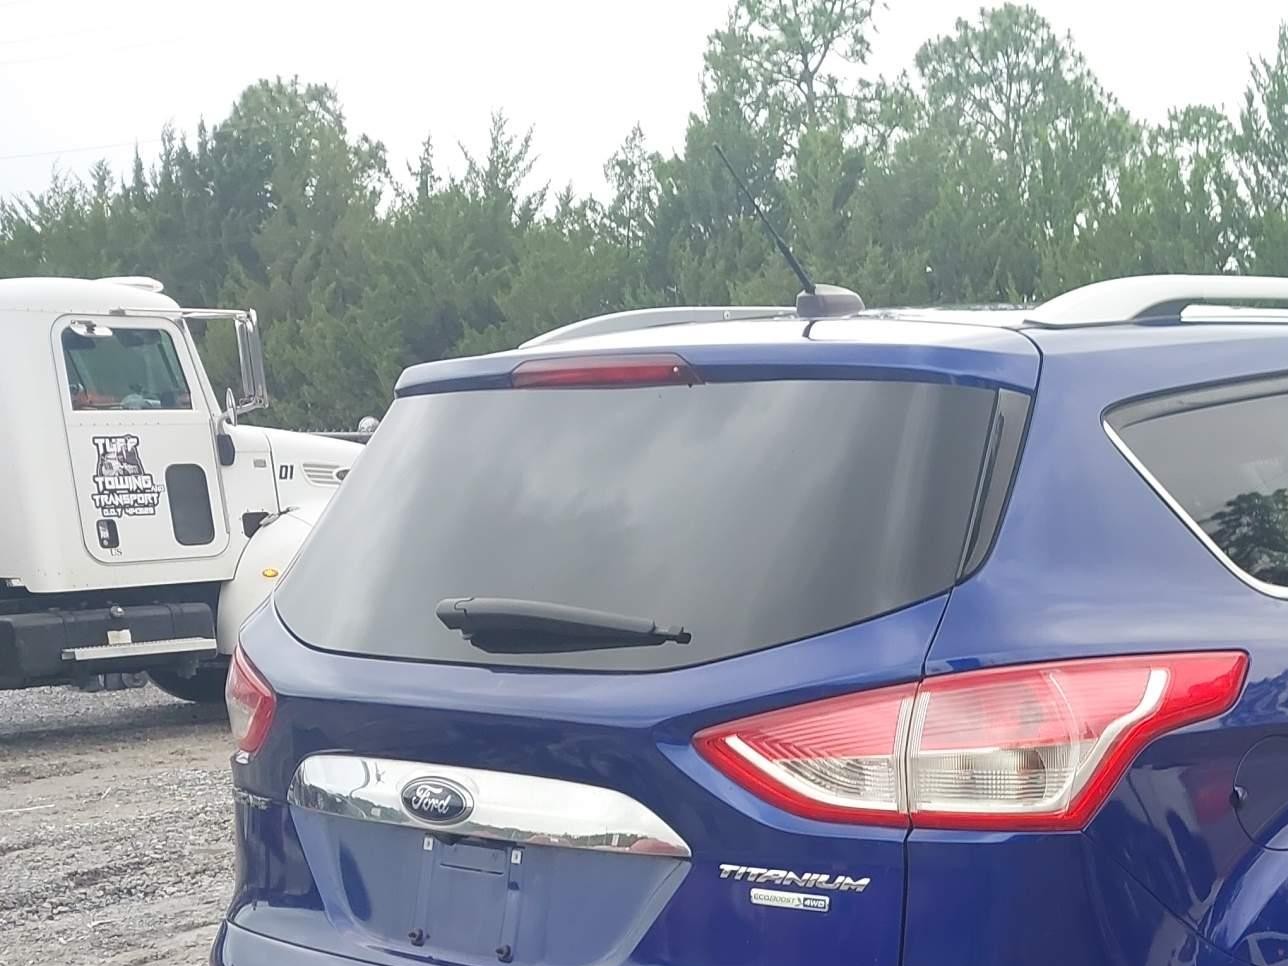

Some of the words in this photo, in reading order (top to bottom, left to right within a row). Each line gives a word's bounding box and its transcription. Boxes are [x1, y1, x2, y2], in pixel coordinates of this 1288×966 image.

[279, 465, 294, 480] 01
[94, 476, 152, 493] TOWING
[92, 493, 159, 507] TRANSPORT
[412, 785, 452, 814] Ford
[719, 863, 871, 893] TITANIUM
[804, 898, 826, 908] 4WD
